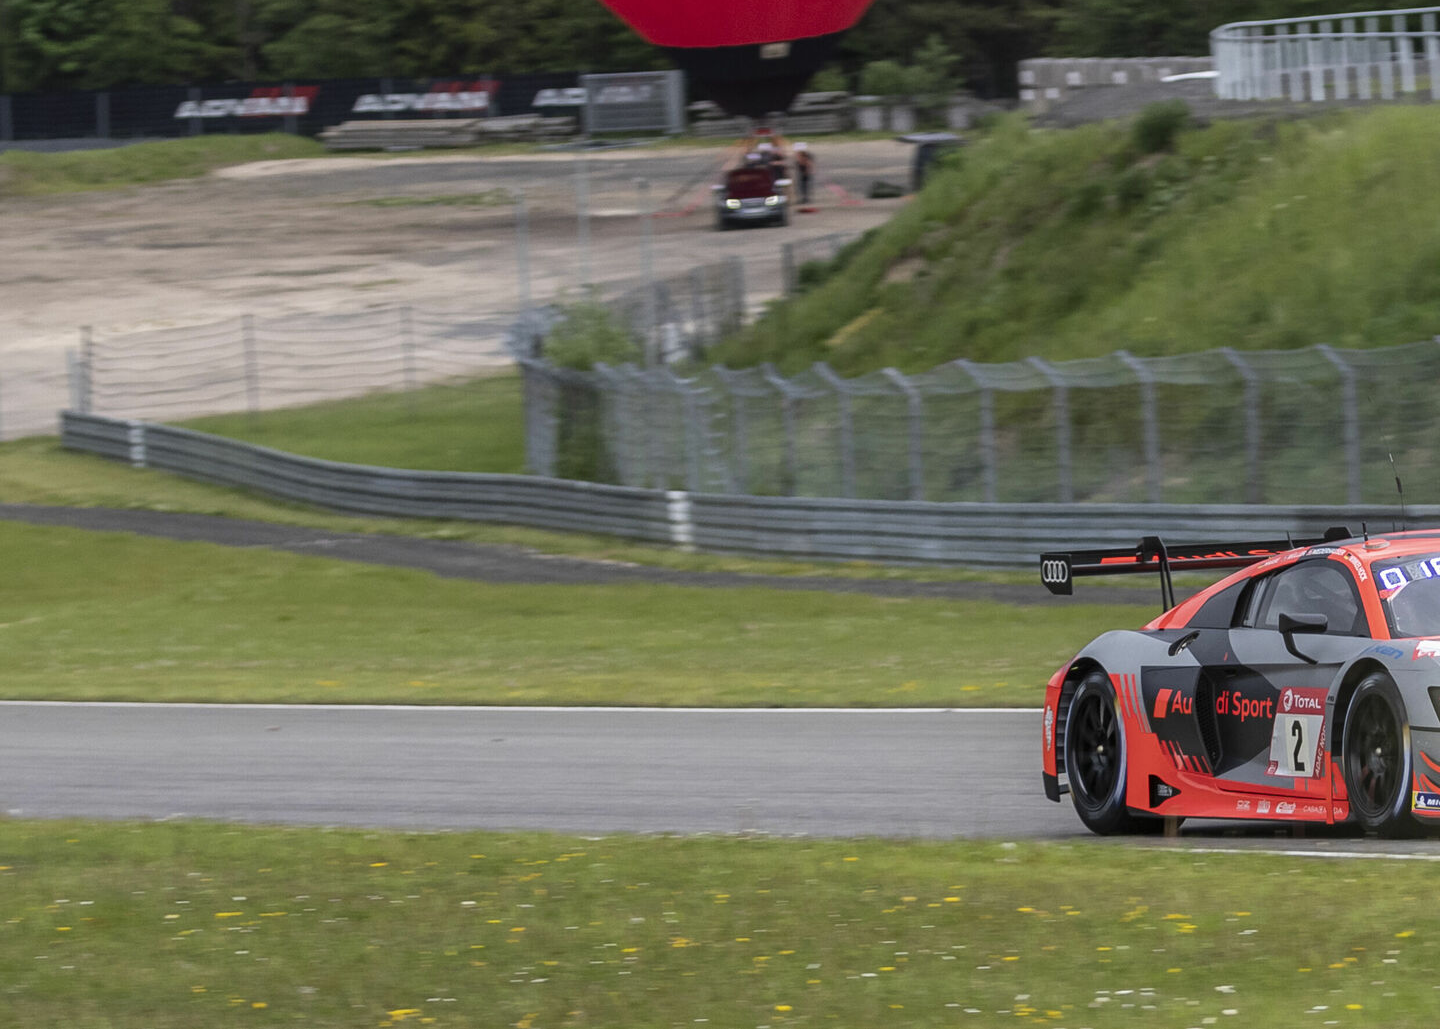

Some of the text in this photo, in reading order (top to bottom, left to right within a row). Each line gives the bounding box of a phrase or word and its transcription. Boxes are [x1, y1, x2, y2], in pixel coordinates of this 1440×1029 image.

[1231, 691, 1273, 722] Sport
[1294, 695, 1321, 709] TOTAL
[1291, 720, 1305, 771] 2
